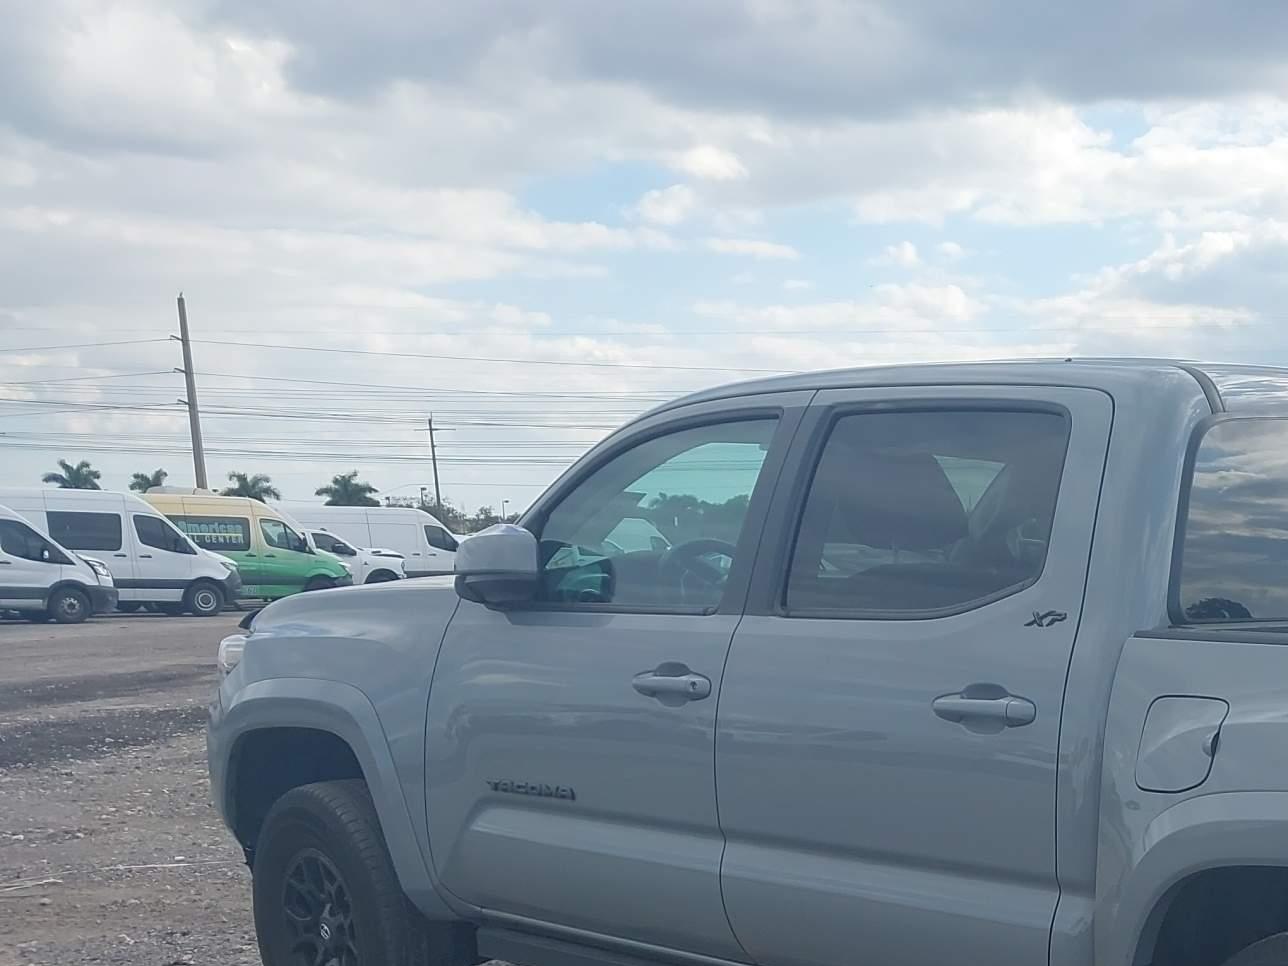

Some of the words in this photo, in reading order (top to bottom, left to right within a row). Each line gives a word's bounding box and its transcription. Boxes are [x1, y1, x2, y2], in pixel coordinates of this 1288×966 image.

[205, 535, 244, 544] CENTER
[1023, 610, 1067, 627] XP
[486, 780, 577, 801] TACOMA
